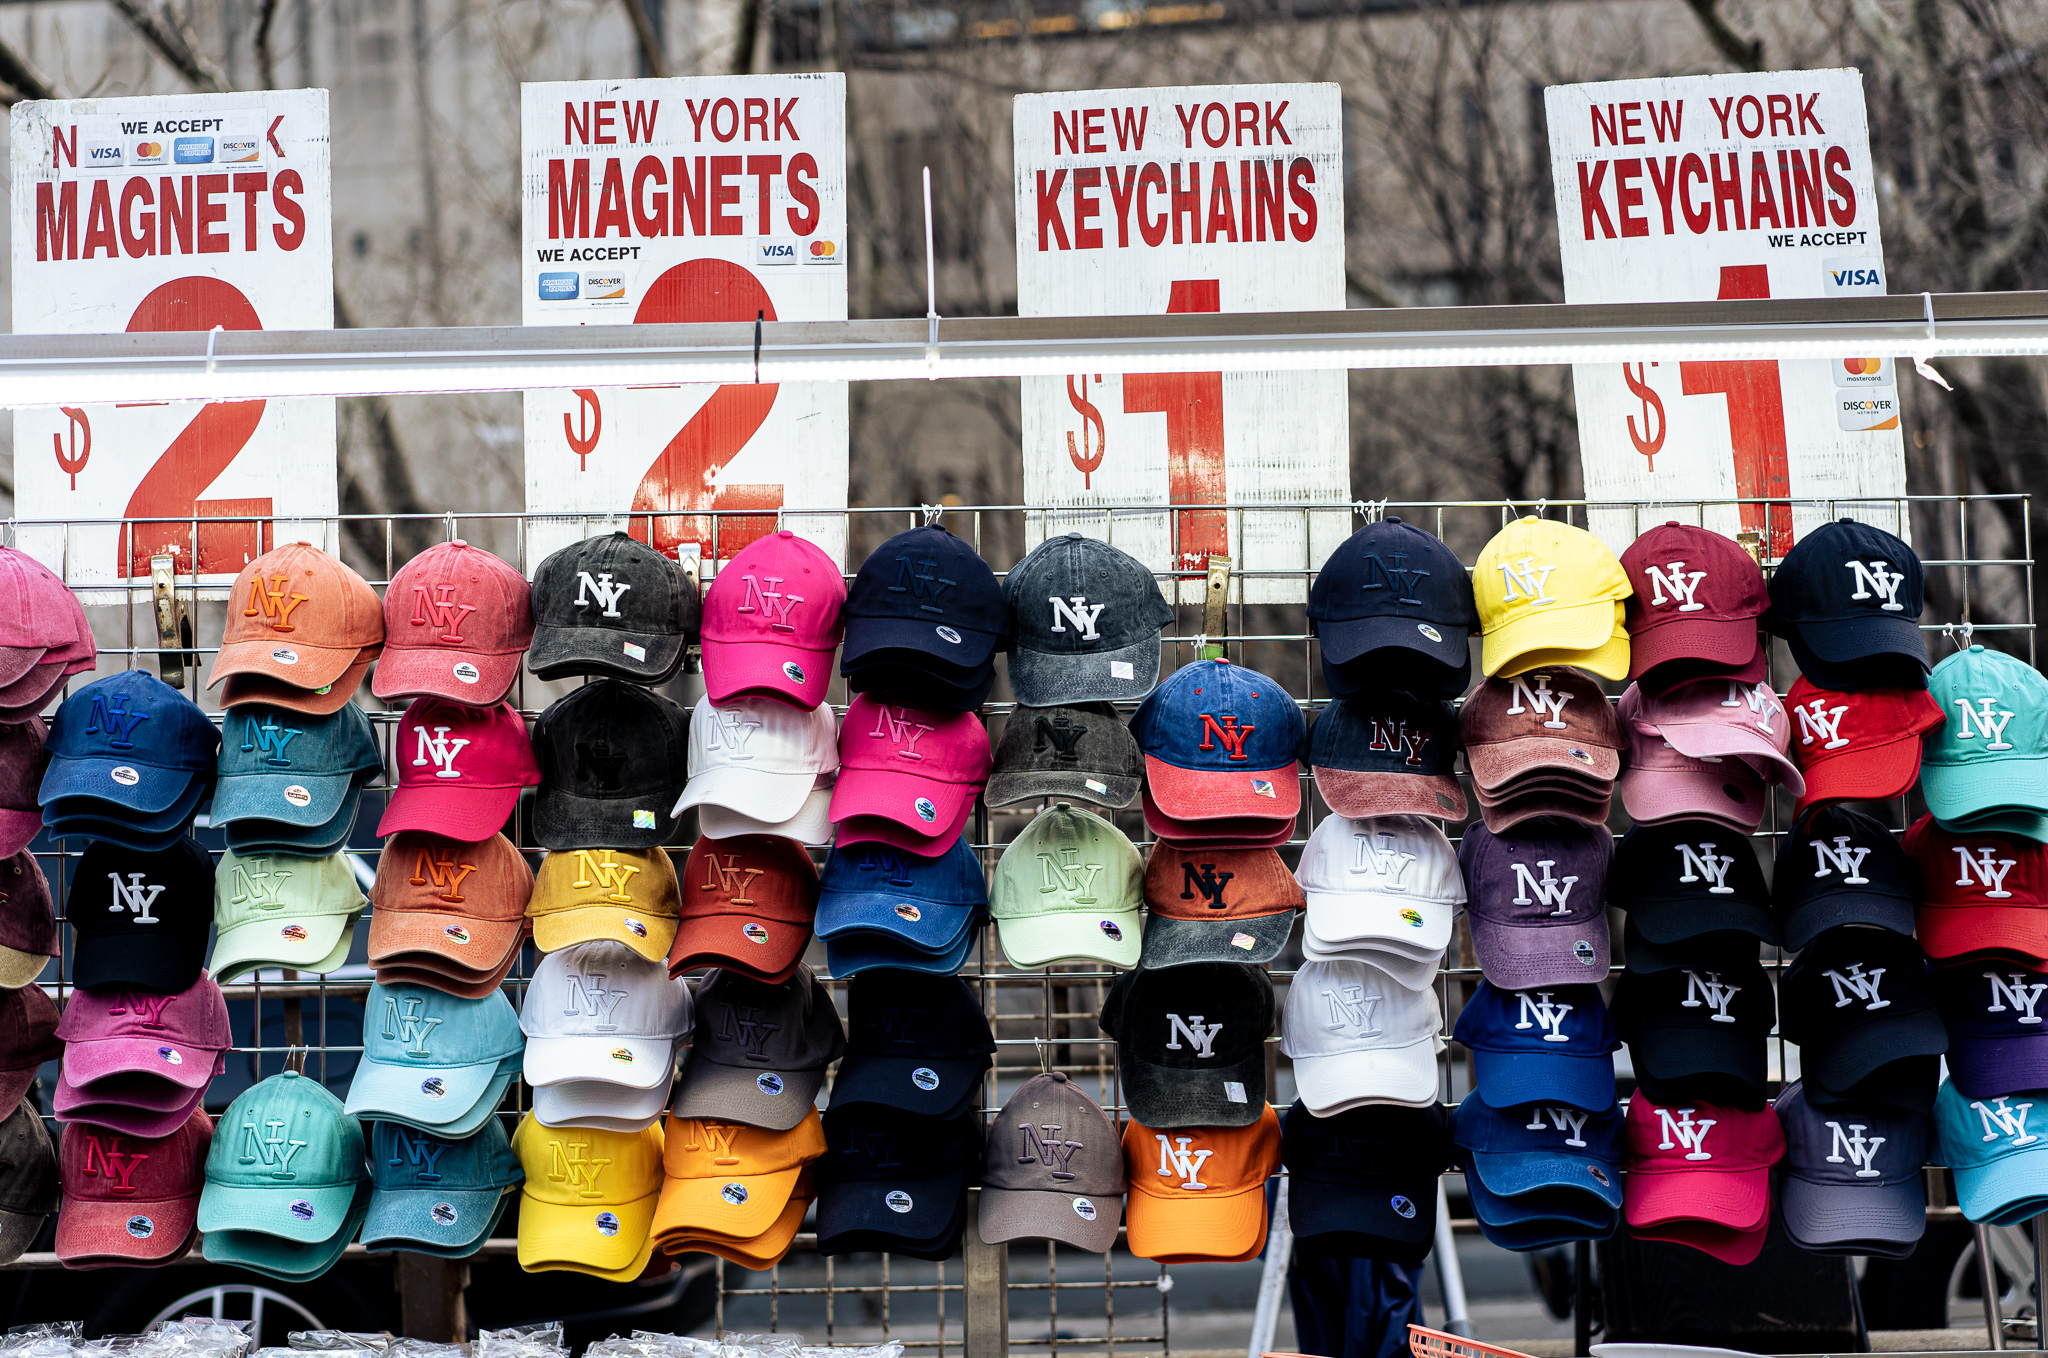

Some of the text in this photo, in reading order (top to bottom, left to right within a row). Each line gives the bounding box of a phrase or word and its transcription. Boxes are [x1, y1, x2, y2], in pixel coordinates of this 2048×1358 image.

[121, 119, 224, 135] WE ACCEPT
[223, 141, 256, 149] DISCOVER
[565, 97, 800, 146] NEW YORK
[1053, 100, 1292, 156] NEW YORK
[1590, 92, 1825, 147] NEW YORK
[89, 147, 121, 159] VISA
[36, 168, 306, 262] MAGNETS
[548, 152, 820, 240] MAGNETS
[1036, 157, 1318, 252] KEYCHAINS
[1577, 145, 1857, 241] KEYCHAINS
[537, 246, 641, 262] WE ACCEPT
[761, 245, 794, 256] VISA
[1768, 231, 1867, 248] WE ACCEPT
[1828, 269, 1880, 286] VISA
[1843, 400, 1892, 411] DISCOVER
[244, 575, 309, 632] NY
[574, 571, 631, 618] NY
[737, 574, 805, 633] NY
[888, 556, 957, 614] NY
[1362, 552, 1431, 606] NY
[1497, 556, 1556, 606] NY
[1644, 561, 1708, 612] NY
[1845, 560, 1905, 611] NY
[411, 584, 477, 644] NY
[1048, 596, 1105, 641] NY
[86, 694, 150, 750] NY
[1506, 675, 1574, 729] NY
[1793, 698, 1850, 750] NY
[1953, 698, 2016, 751] NY
[241, 713, 303, 766] NY
[412, 725, 471, 779] NY
[706, 709, 763, 760] NY
[868, 703, 935, 760] NY
[1033, 716, 1088, 762] NY
[1198, 714, 1255, 761] NY
[1369, 716, 1430, 766] NY
[230, 857, 294, 910] NY
[409, 846, 478, 903] NY
[572, 849, 641, 902] NY
[701, 853, 764, 906] NY
[1036, 848, 1103, 904] NY
[1180, 862, 1235, 910] NY
[1349, 831, 1417, 891] NY
[1674, 842, 1735, 895] NY
[1809, 836, 1872, 885] NY
[1952, 846, 2017, 899] NY
[108, 872, 166, 924] NY
[1510, 860, 1579, 917] NY
[563, 974, 629, 1032] NY
[1320, 985, 1383, 1039] NY
[1681, 969, 1742, 1023] NY
[1821, 962, 1891, 1011] NY
[1983, 971, 2048, 1025] NY
[381, 996, 443, 1058] NY
[717, 1002, 781, 1062] NY
[1165, 1013, 1223, 1058] NY
[1514, 991, 1574, 1043] NY
[1653, 1108, 1718, 1161] NY
[1970, 1095, 2038, 1147] NY
[82, 1135, 150, 1195] NY
[238, 1120, 307, 1180] NY
[388, 1127, 455, 1181] NY
[547, 1139, 613, 1199] NY
[1018, 1122, 1084, 1180] NY
[1155, 1134, 1214, 1190] NY
[1824, 1121, 1887, 1178] NY
